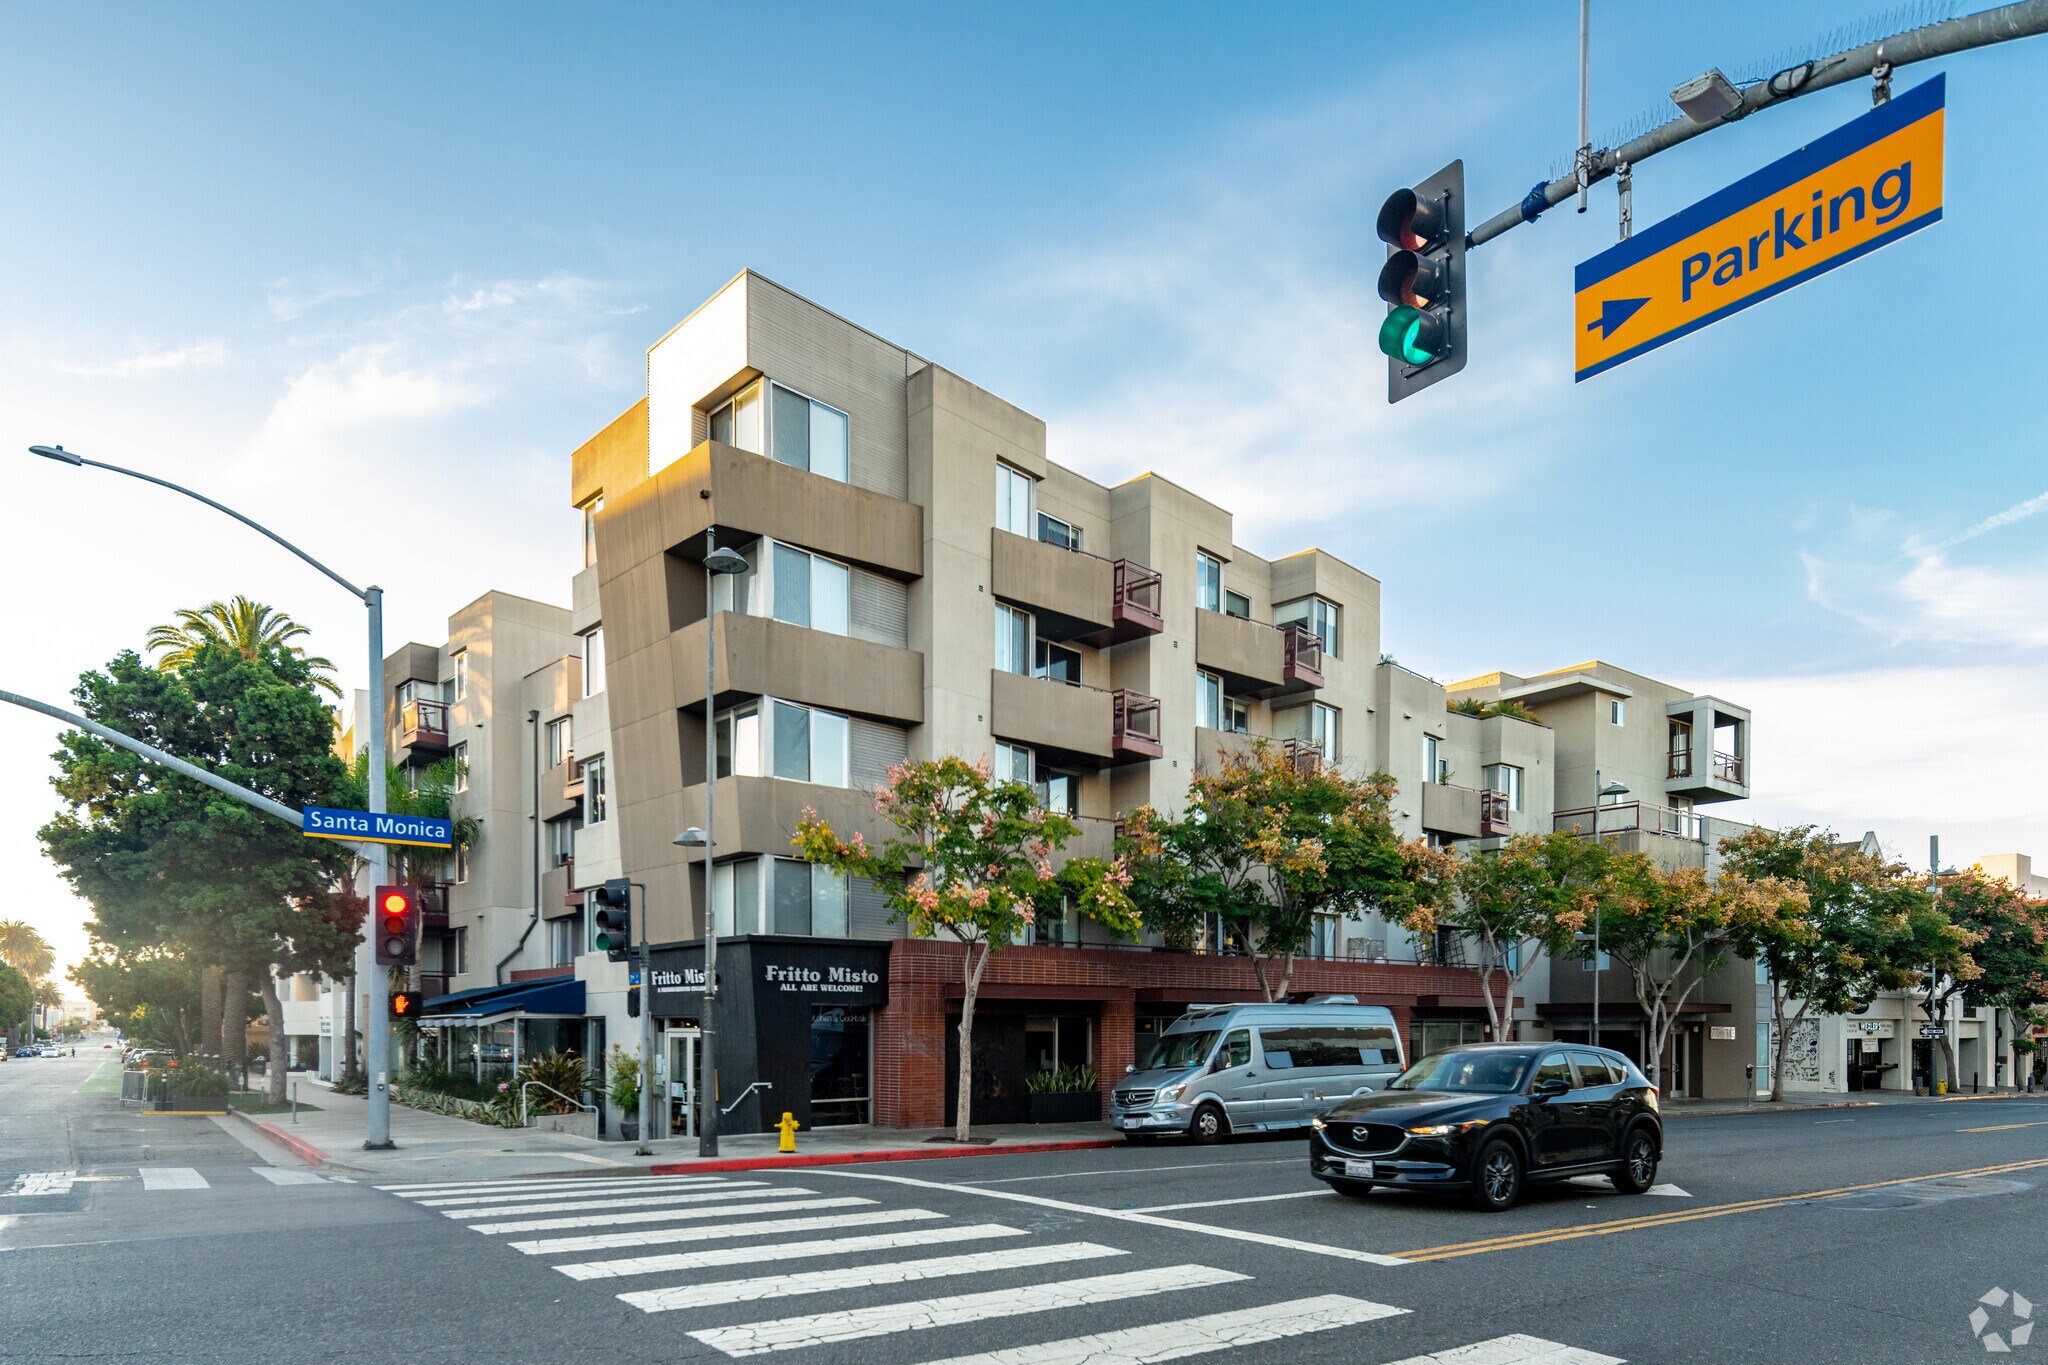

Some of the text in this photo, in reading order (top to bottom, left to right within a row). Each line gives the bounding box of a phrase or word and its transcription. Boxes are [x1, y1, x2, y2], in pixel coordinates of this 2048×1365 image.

[1682, 160, 1912, 303] Parking
[311, 811, 445, 838] Santa Monica
[651, 971, 682, 985] Fritto
[684, 969, 706, 983] Mis
[765, 965, 879, 983] Fritto Misto
[820, 984, 863, 992] WELCOME!
